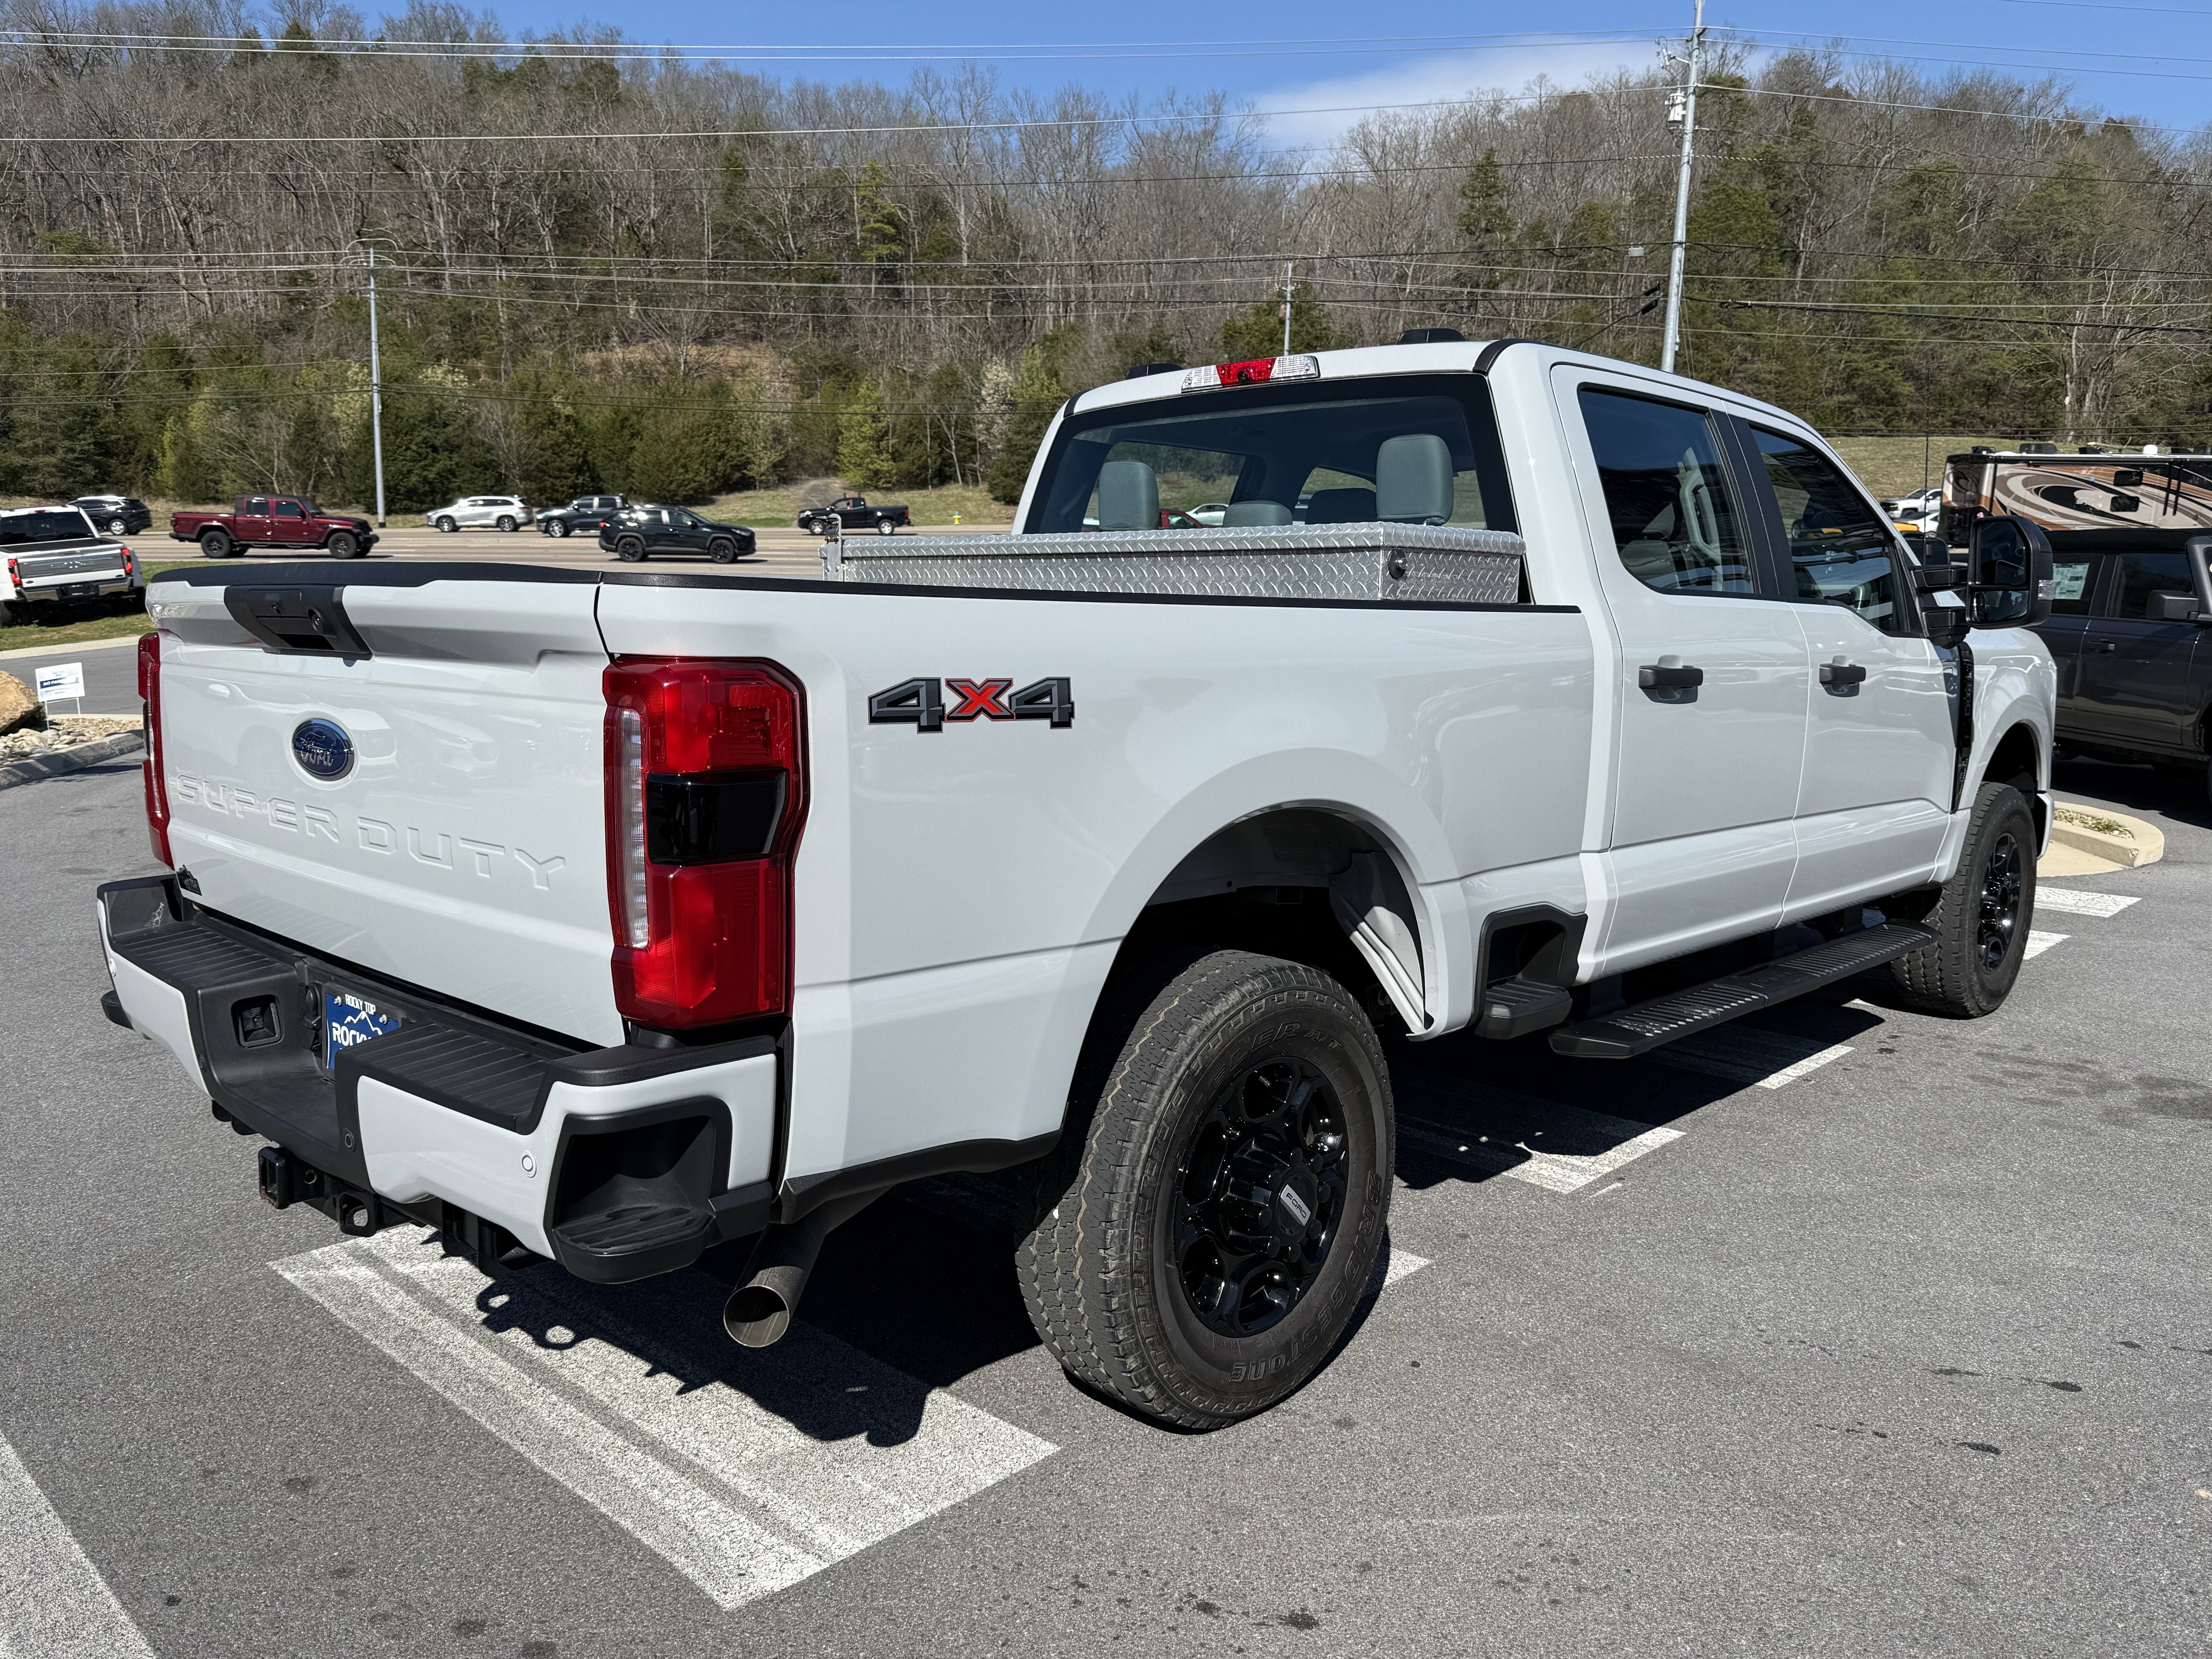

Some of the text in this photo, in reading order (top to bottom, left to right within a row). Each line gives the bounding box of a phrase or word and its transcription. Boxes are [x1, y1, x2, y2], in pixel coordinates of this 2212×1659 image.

[175, 773, 565, 890] SUPER DUTY
[345, 994, 376, 1015] ROCKY TOP
[1304, 1028, 1343, 1049] A/T
[1286, 1192, 1307, 1219] FORD
[1228, 1170, 1381, 1382] BRIDGESTONE
